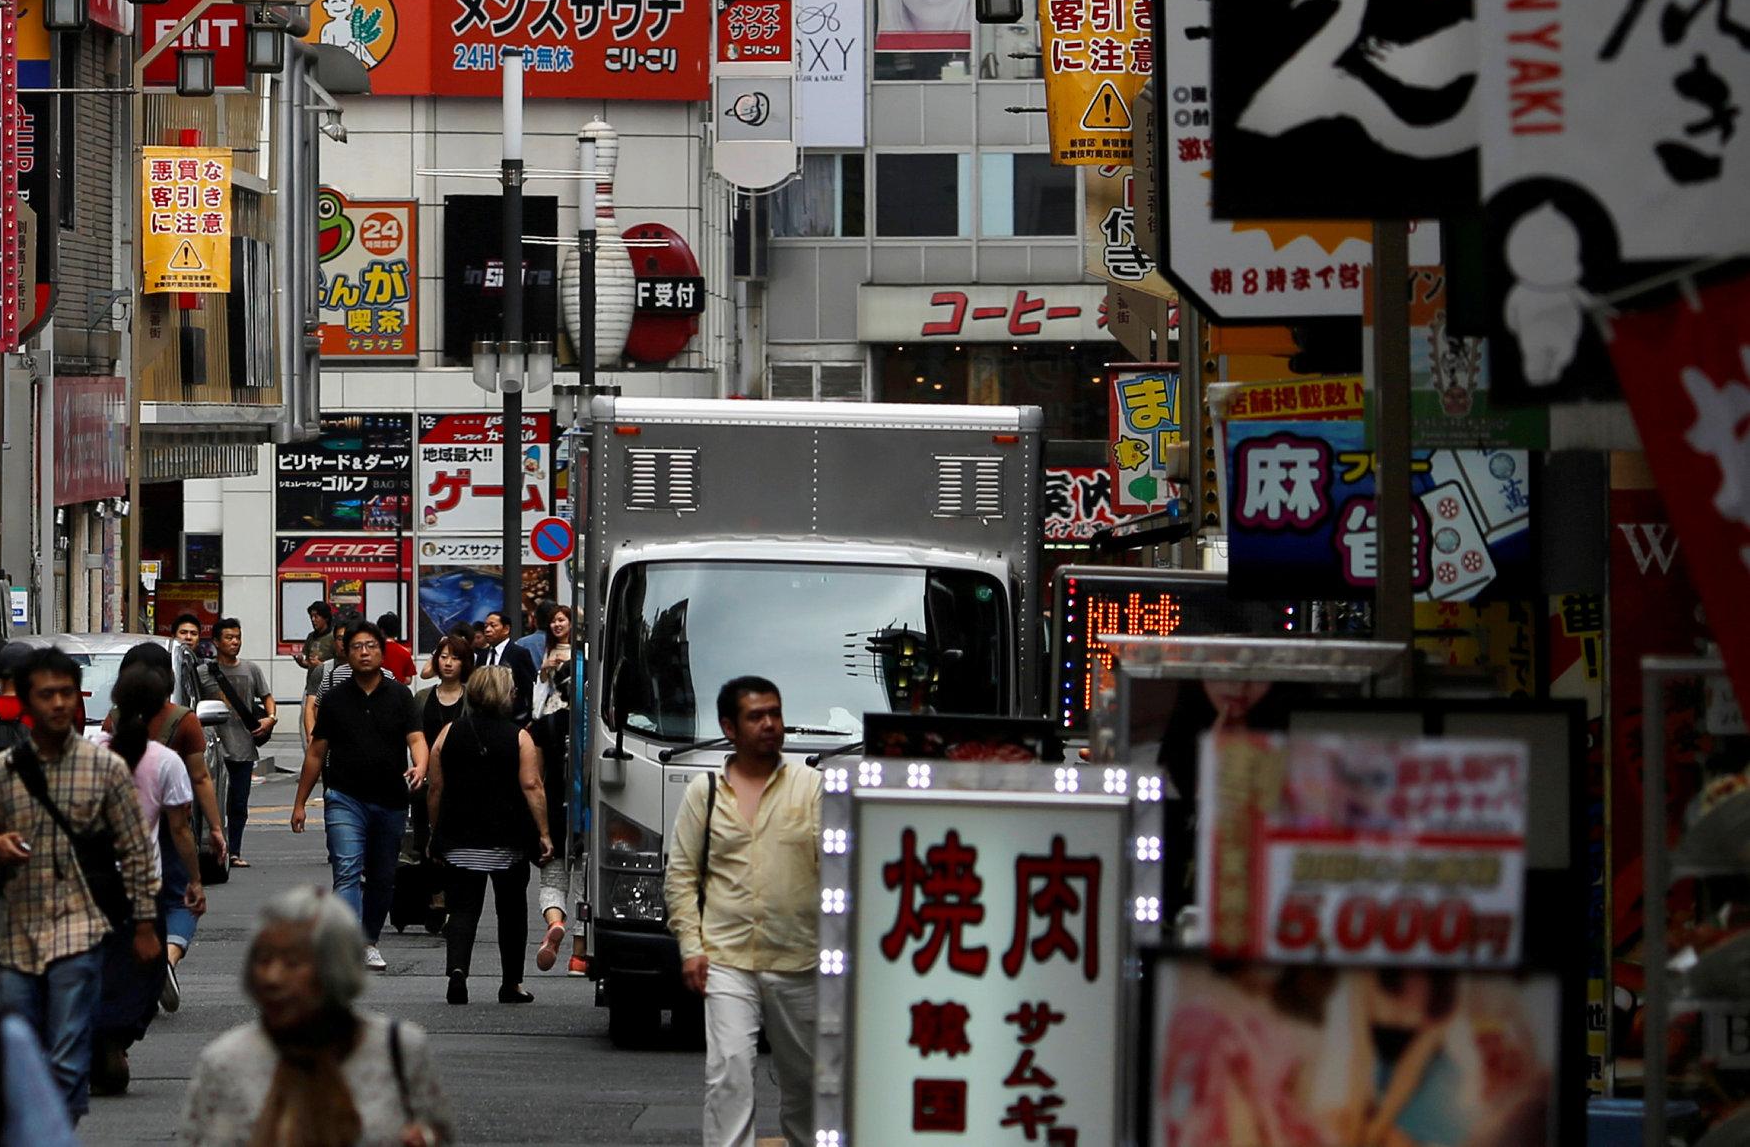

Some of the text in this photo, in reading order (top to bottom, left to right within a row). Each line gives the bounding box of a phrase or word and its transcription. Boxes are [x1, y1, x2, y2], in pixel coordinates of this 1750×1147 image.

[730, 5, 780, 22] メンズ
[729, 22, 780, 40] サウナ
[454, 44, 494, 72] 24H
[150, 159, 223, 182] 悪質な
[150, 186, 223, 209] 客引き
[150, 213, 224, 235] に注意
[362, 219, 400, 239] 24
[346, 310, 404, 335] 喫茶
[921, 290, 1081, 337] コーヒー
[278, 454, 410, 471] ビリヤード&ダーツ
[422, 447, 494, 463] 地域最大!!
[304, 543, 398, 557] FACE
[880, 827, 1103, 983] 焼肉
